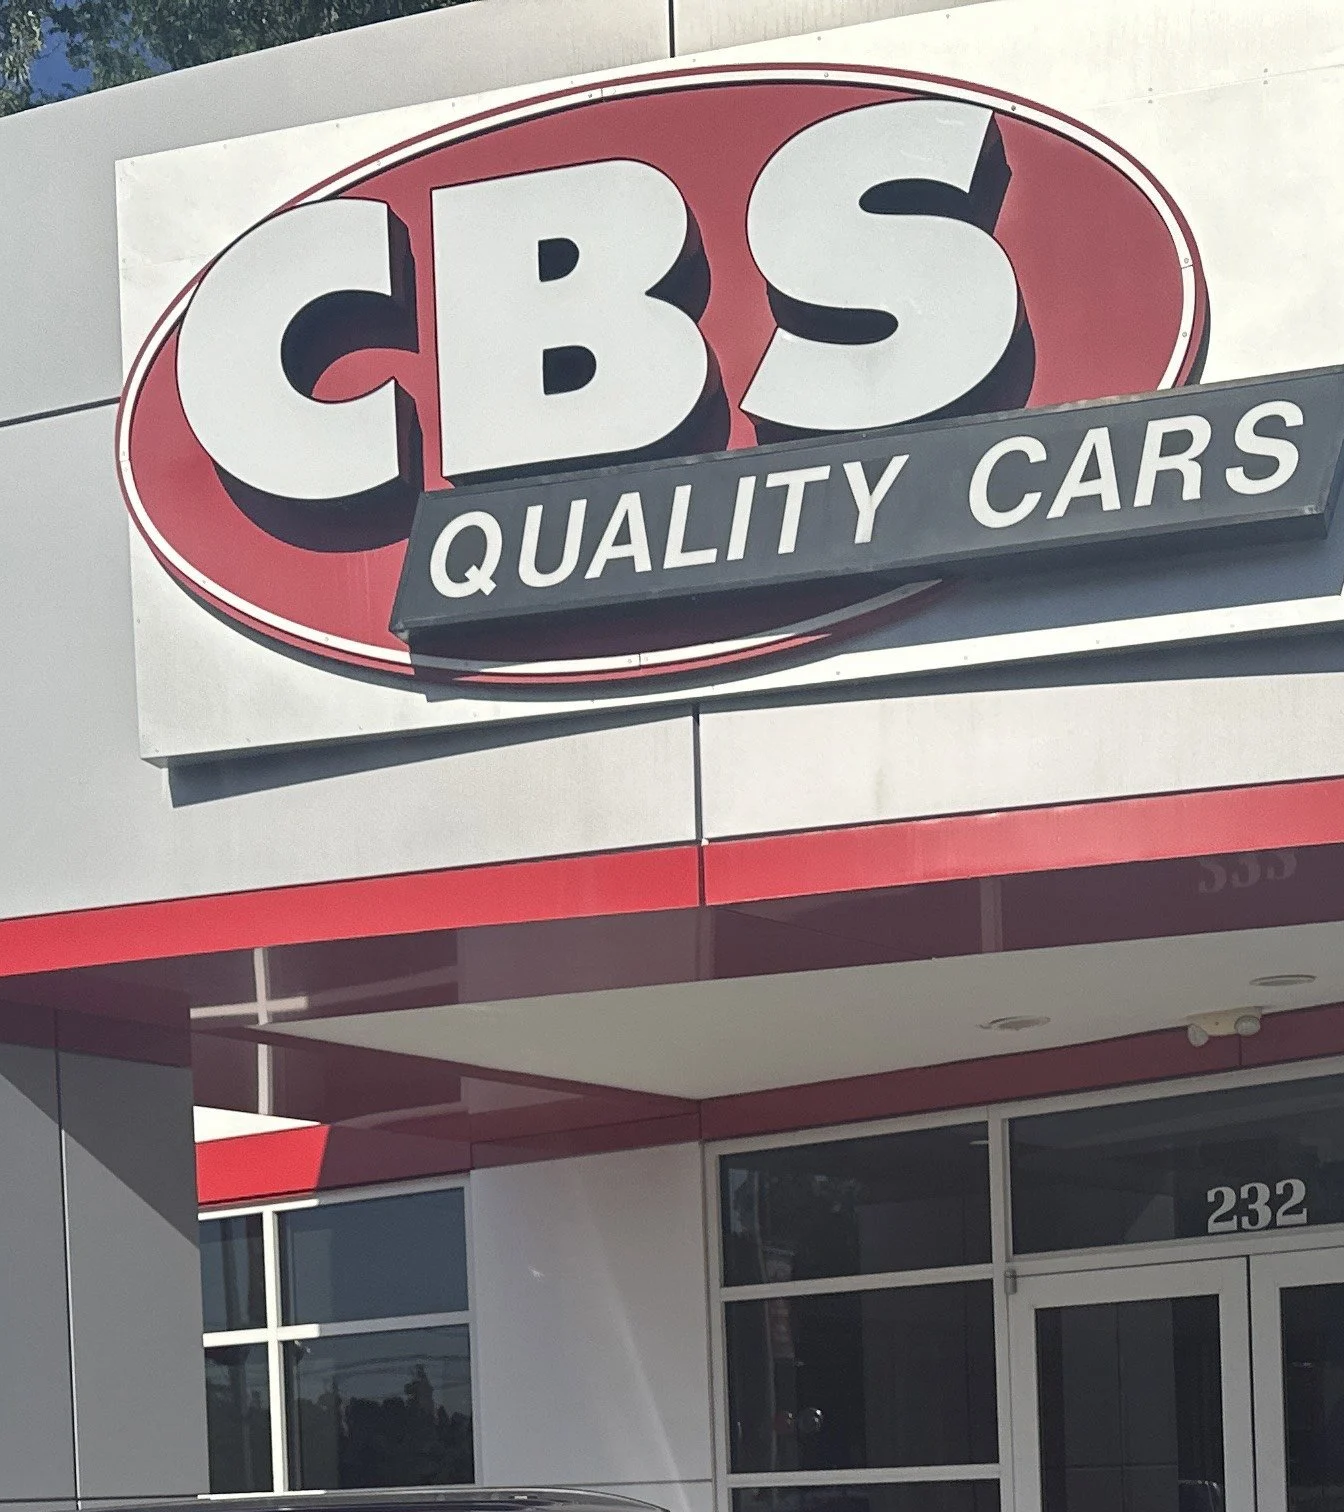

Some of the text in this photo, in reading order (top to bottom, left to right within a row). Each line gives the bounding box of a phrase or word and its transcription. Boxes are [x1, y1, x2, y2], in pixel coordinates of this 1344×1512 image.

[176, 97, 1019, 501] CBS
[429, 400, 1306, 598] QUALITY CARS
[1206, 1178, 1308, 1234] 232
